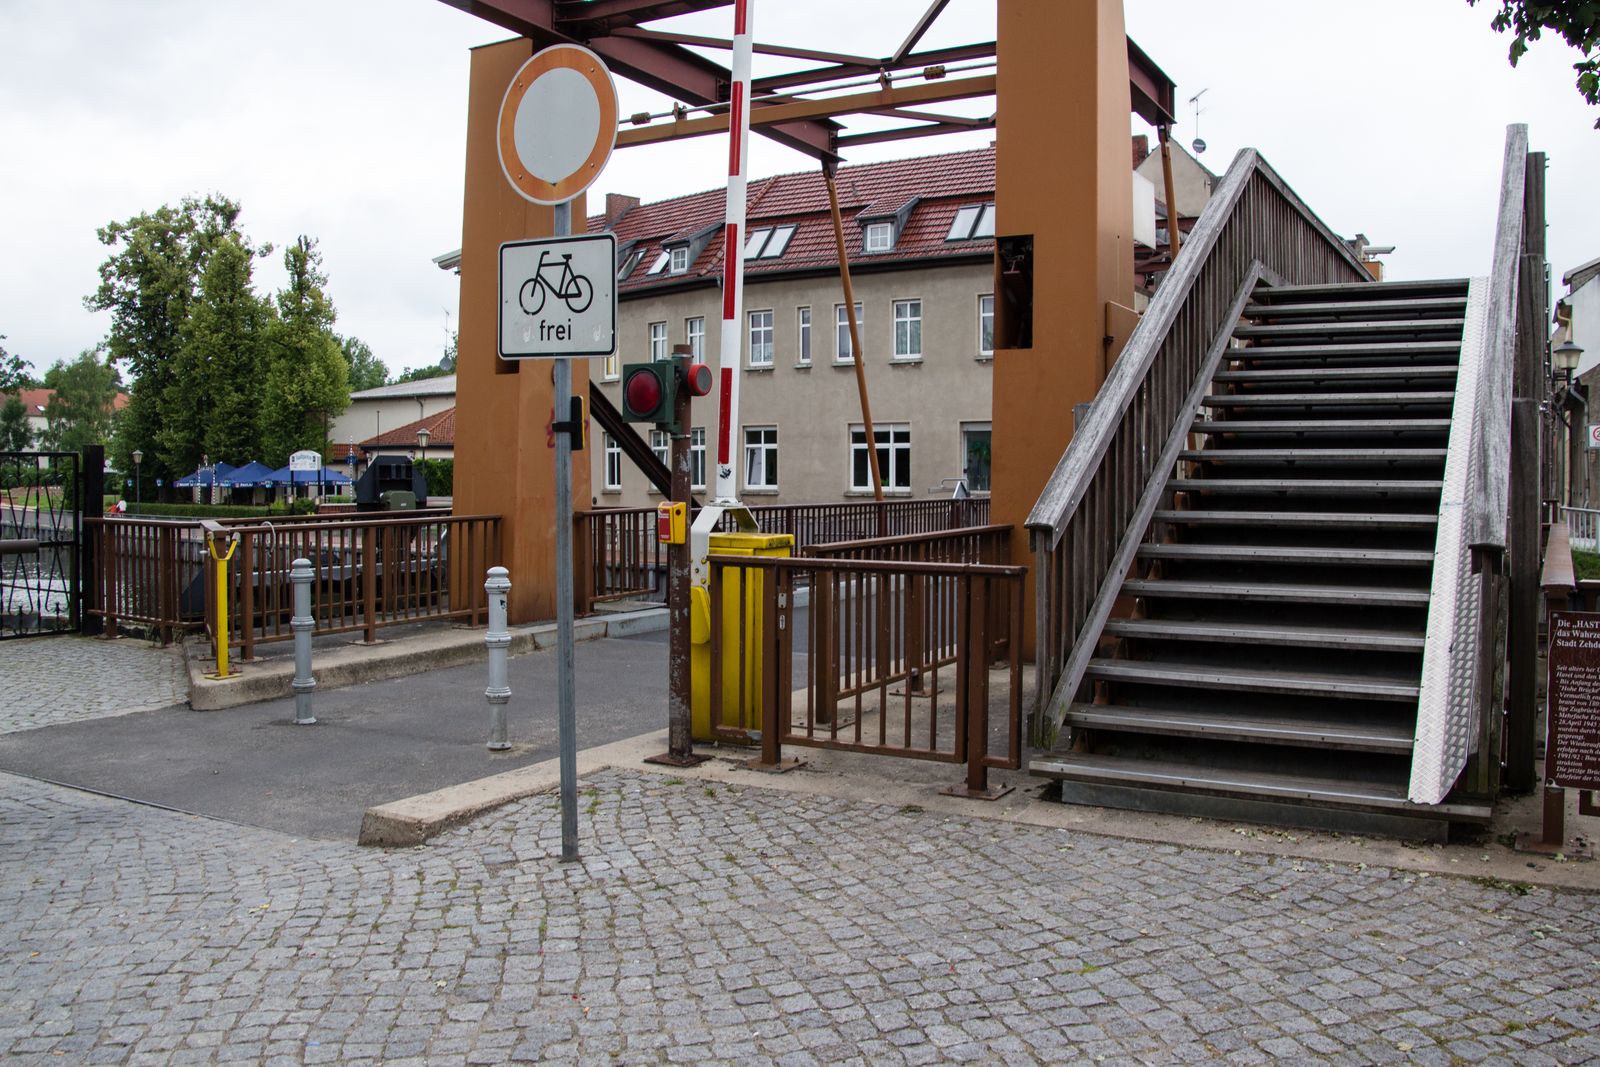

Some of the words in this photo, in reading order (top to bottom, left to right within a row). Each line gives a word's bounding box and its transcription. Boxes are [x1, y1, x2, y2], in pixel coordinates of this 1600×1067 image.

[540, 318, 572, 341] frei
[1558, 619, 1570, 628] Die
[1557, 629, 1570, 637] das
[1556, 638, 1576, 647] Stadt
